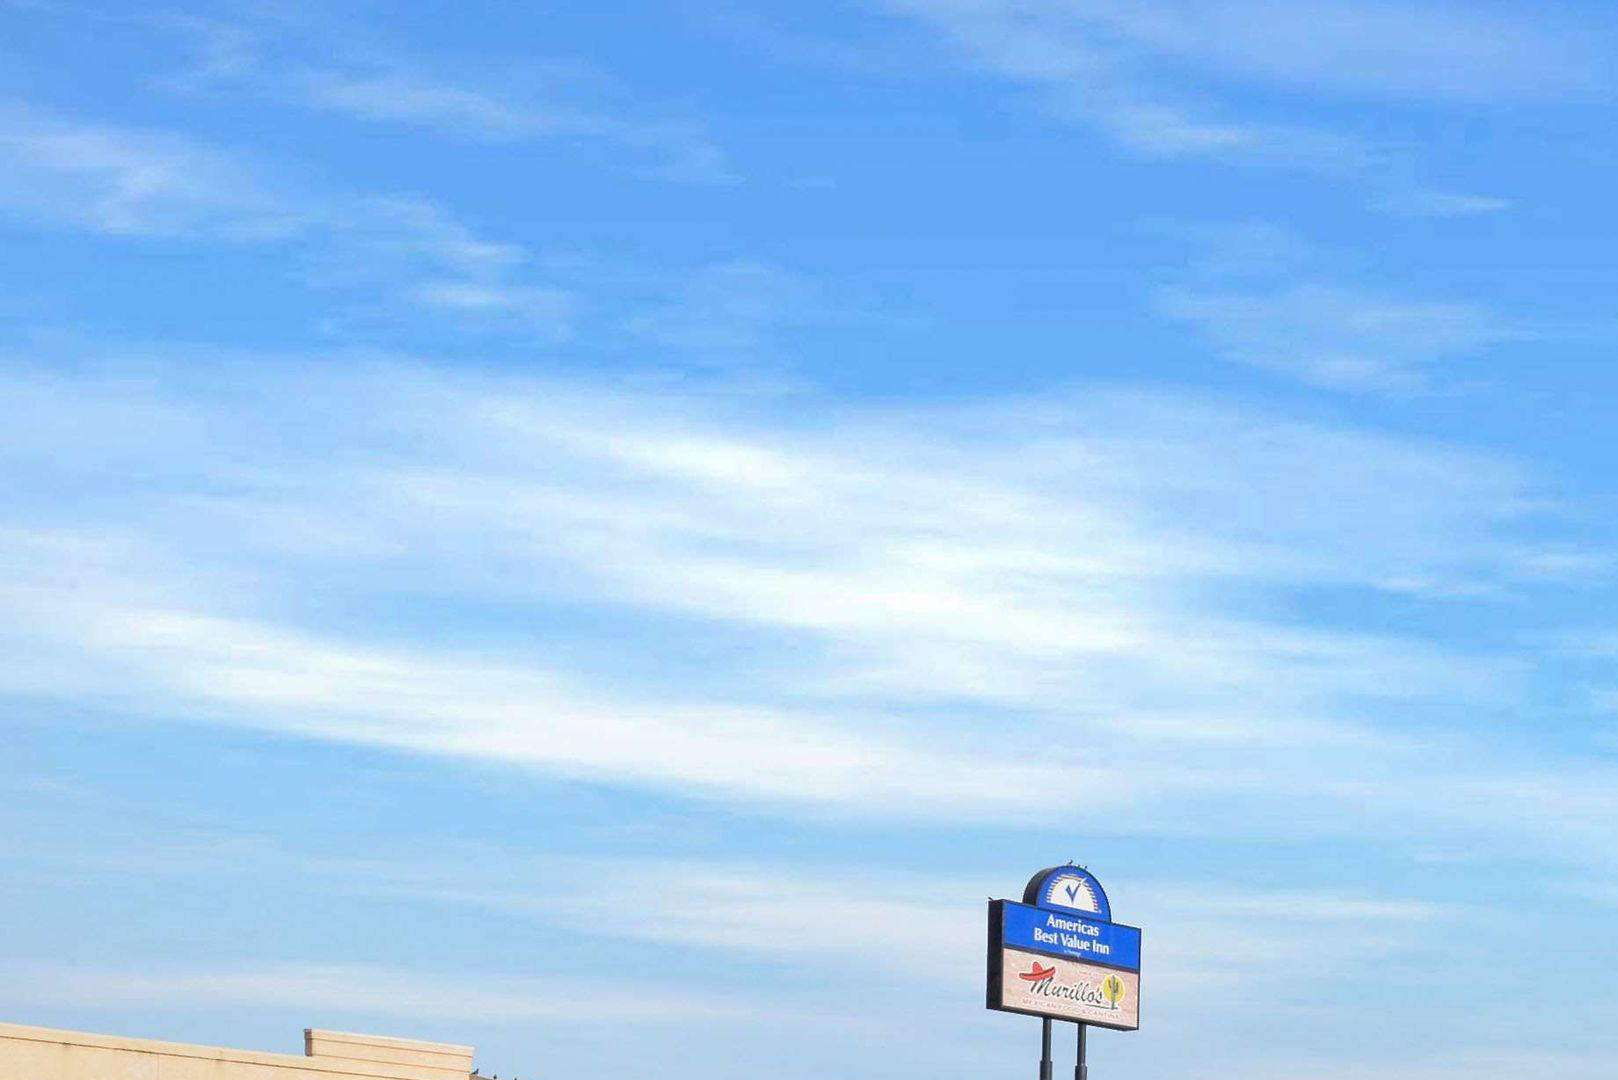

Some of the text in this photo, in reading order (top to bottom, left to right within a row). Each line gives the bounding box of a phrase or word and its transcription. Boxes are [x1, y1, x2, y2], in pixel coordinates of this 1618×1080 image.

[1046, 914, 1100, 936] Americas
[1034, 927, 1058, 945] Best
[1060, 933, 1091, 951] Value
[1092, 940, 1110, 955] Inn
[1030, 976, 1103, 1004] Murillo's
